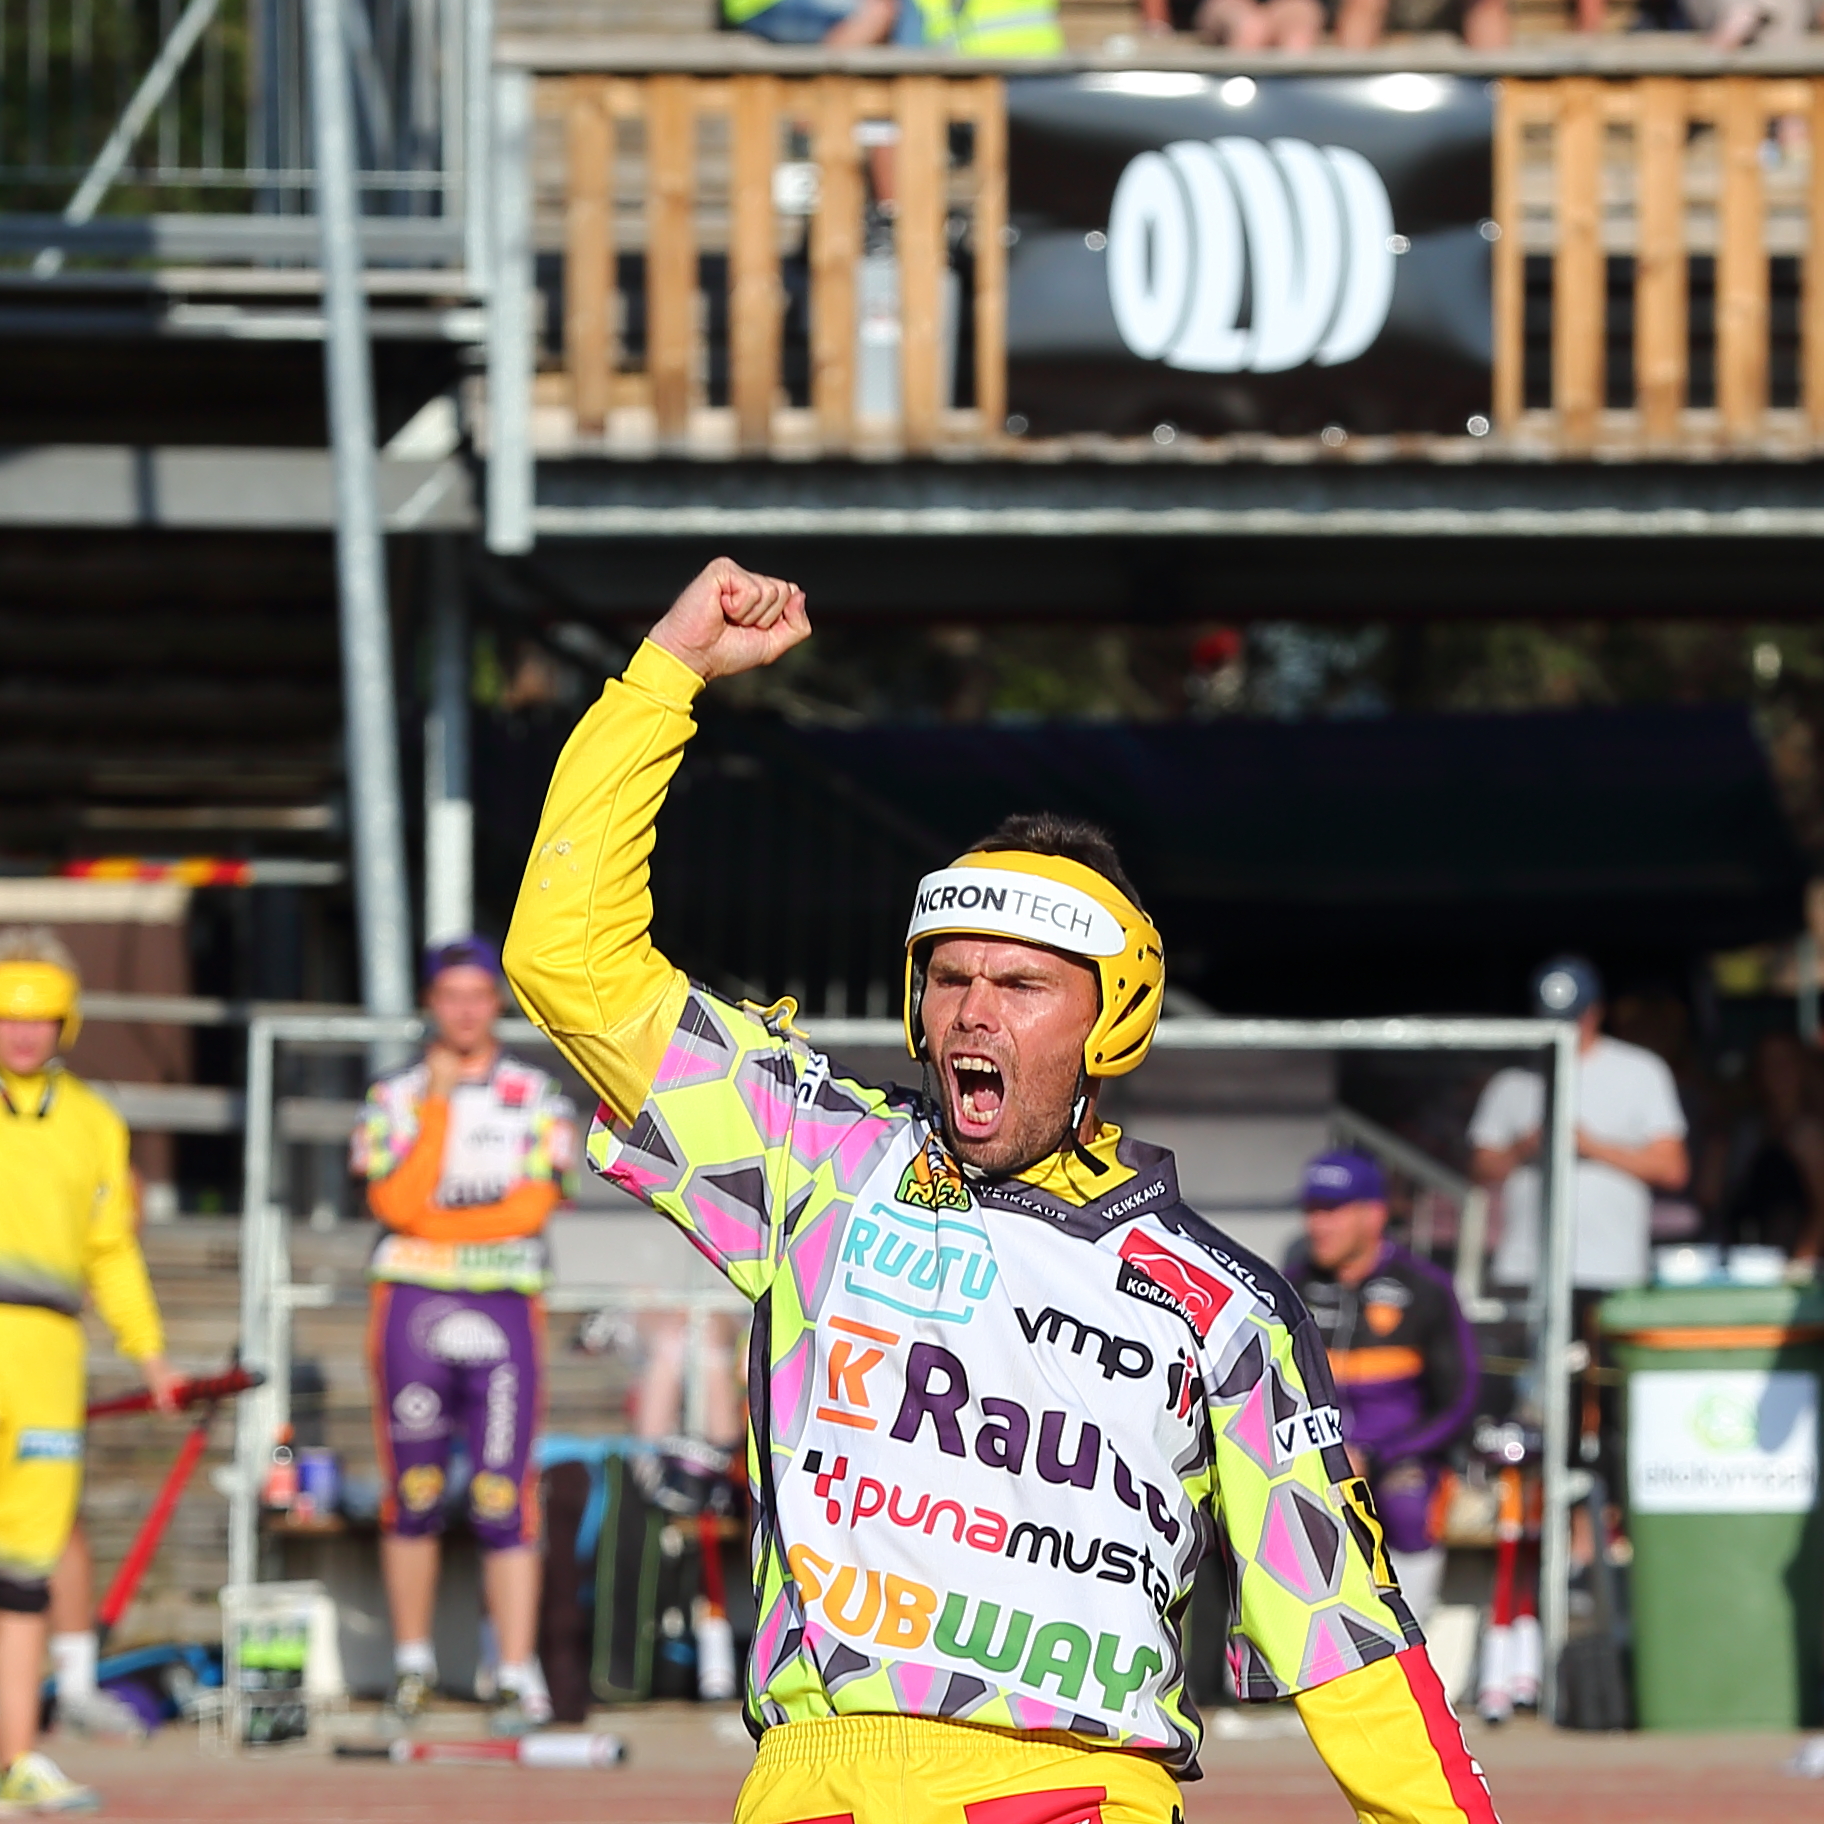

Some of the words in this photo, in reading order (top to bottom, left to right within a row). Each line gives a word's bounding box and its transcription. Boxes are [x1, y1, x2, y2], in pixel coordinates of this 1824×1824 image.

[979, 1184, 1069, 1223] VEIKKAUS
[1101, 1180, 1167, 1222] VEIKKAUS
[841, 1216, 999, 1301] RUUTU
[1014, 1305, 1155, 1381] vmp
[828, 1339, 885, 1408] K
[889, 1341, 1180, 1546] Rauta
[851, 1475, 1170, 1615] punamusta
[787, 1542, 1163, 1714] SUBWAY
